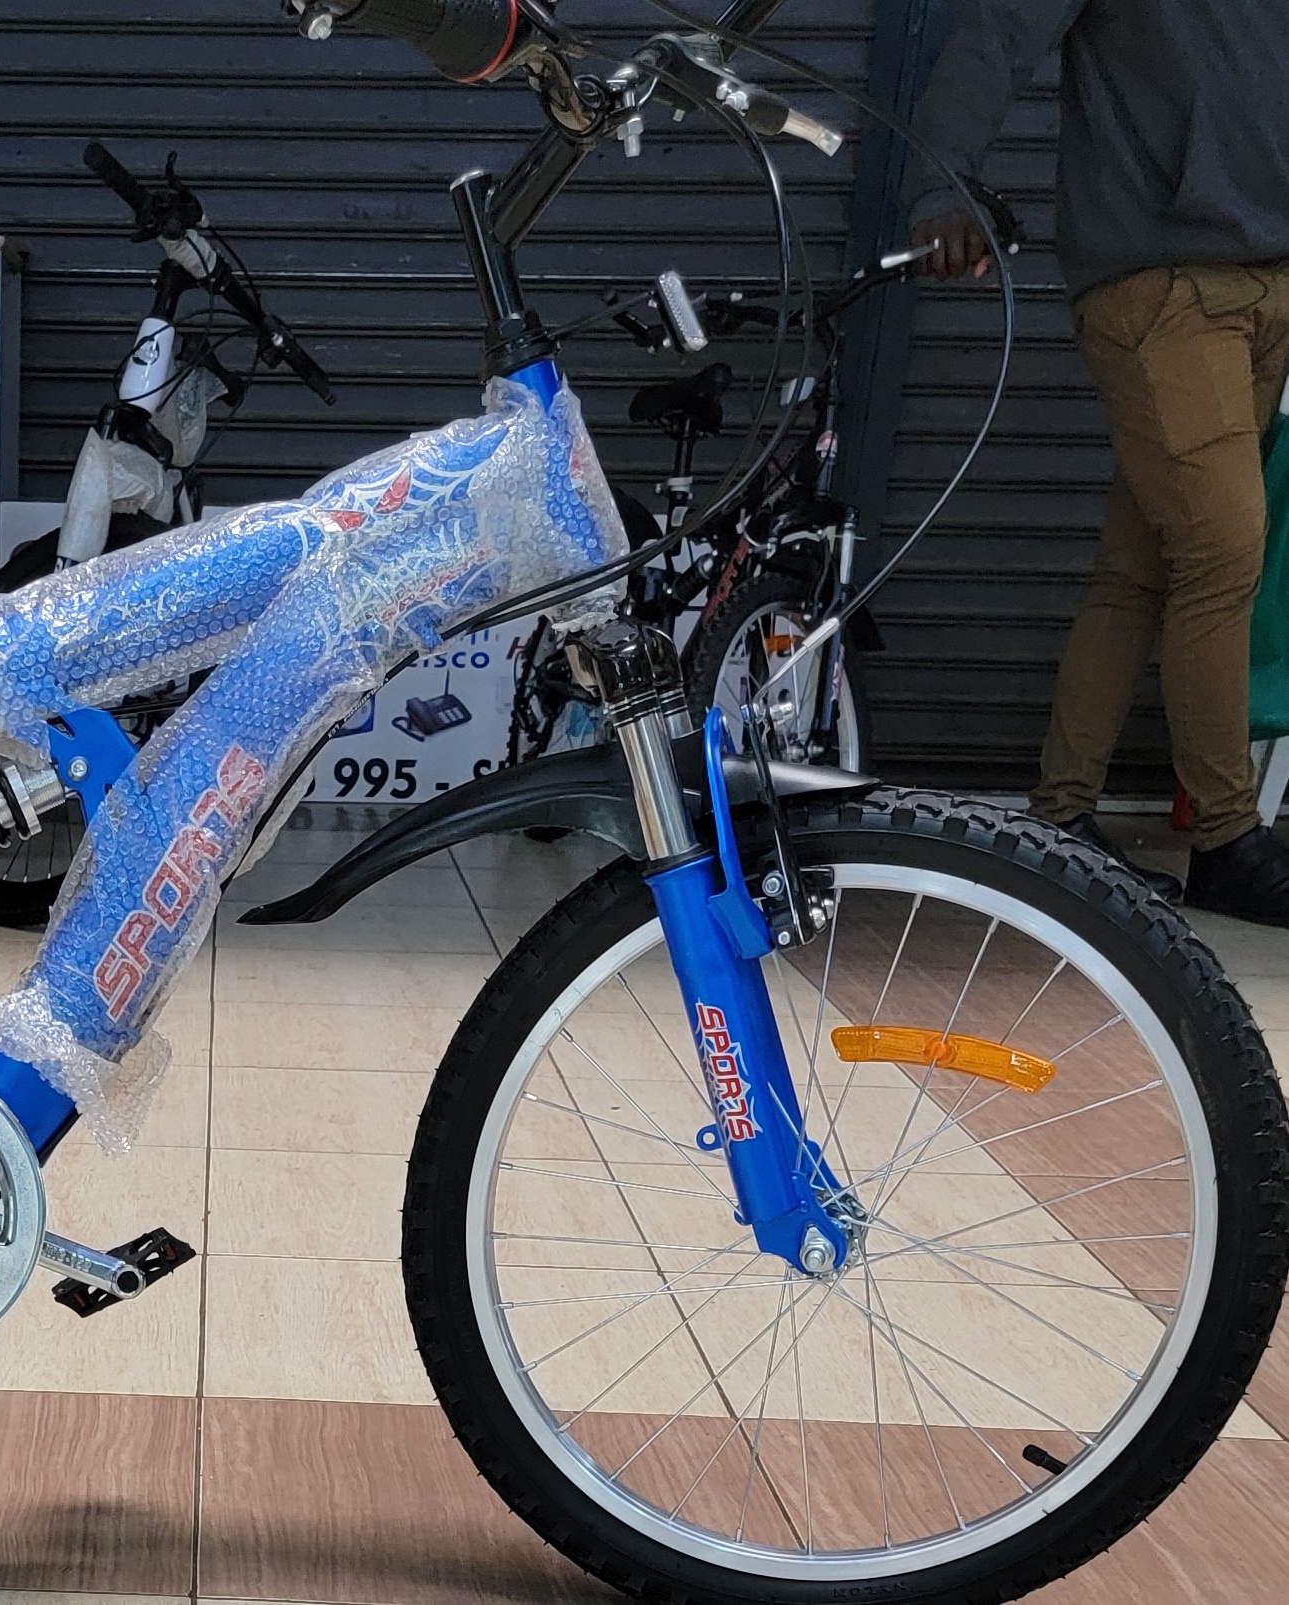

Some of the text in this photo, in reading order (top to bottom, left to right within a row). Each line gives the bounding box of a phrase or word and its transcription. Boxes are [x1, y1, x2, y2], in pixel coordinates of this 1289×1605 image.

[333, 757, 417, 799] 995
[92, 741, 266, 1023] SPORTS
[695, 1003, 756, 1142] SPORTS
